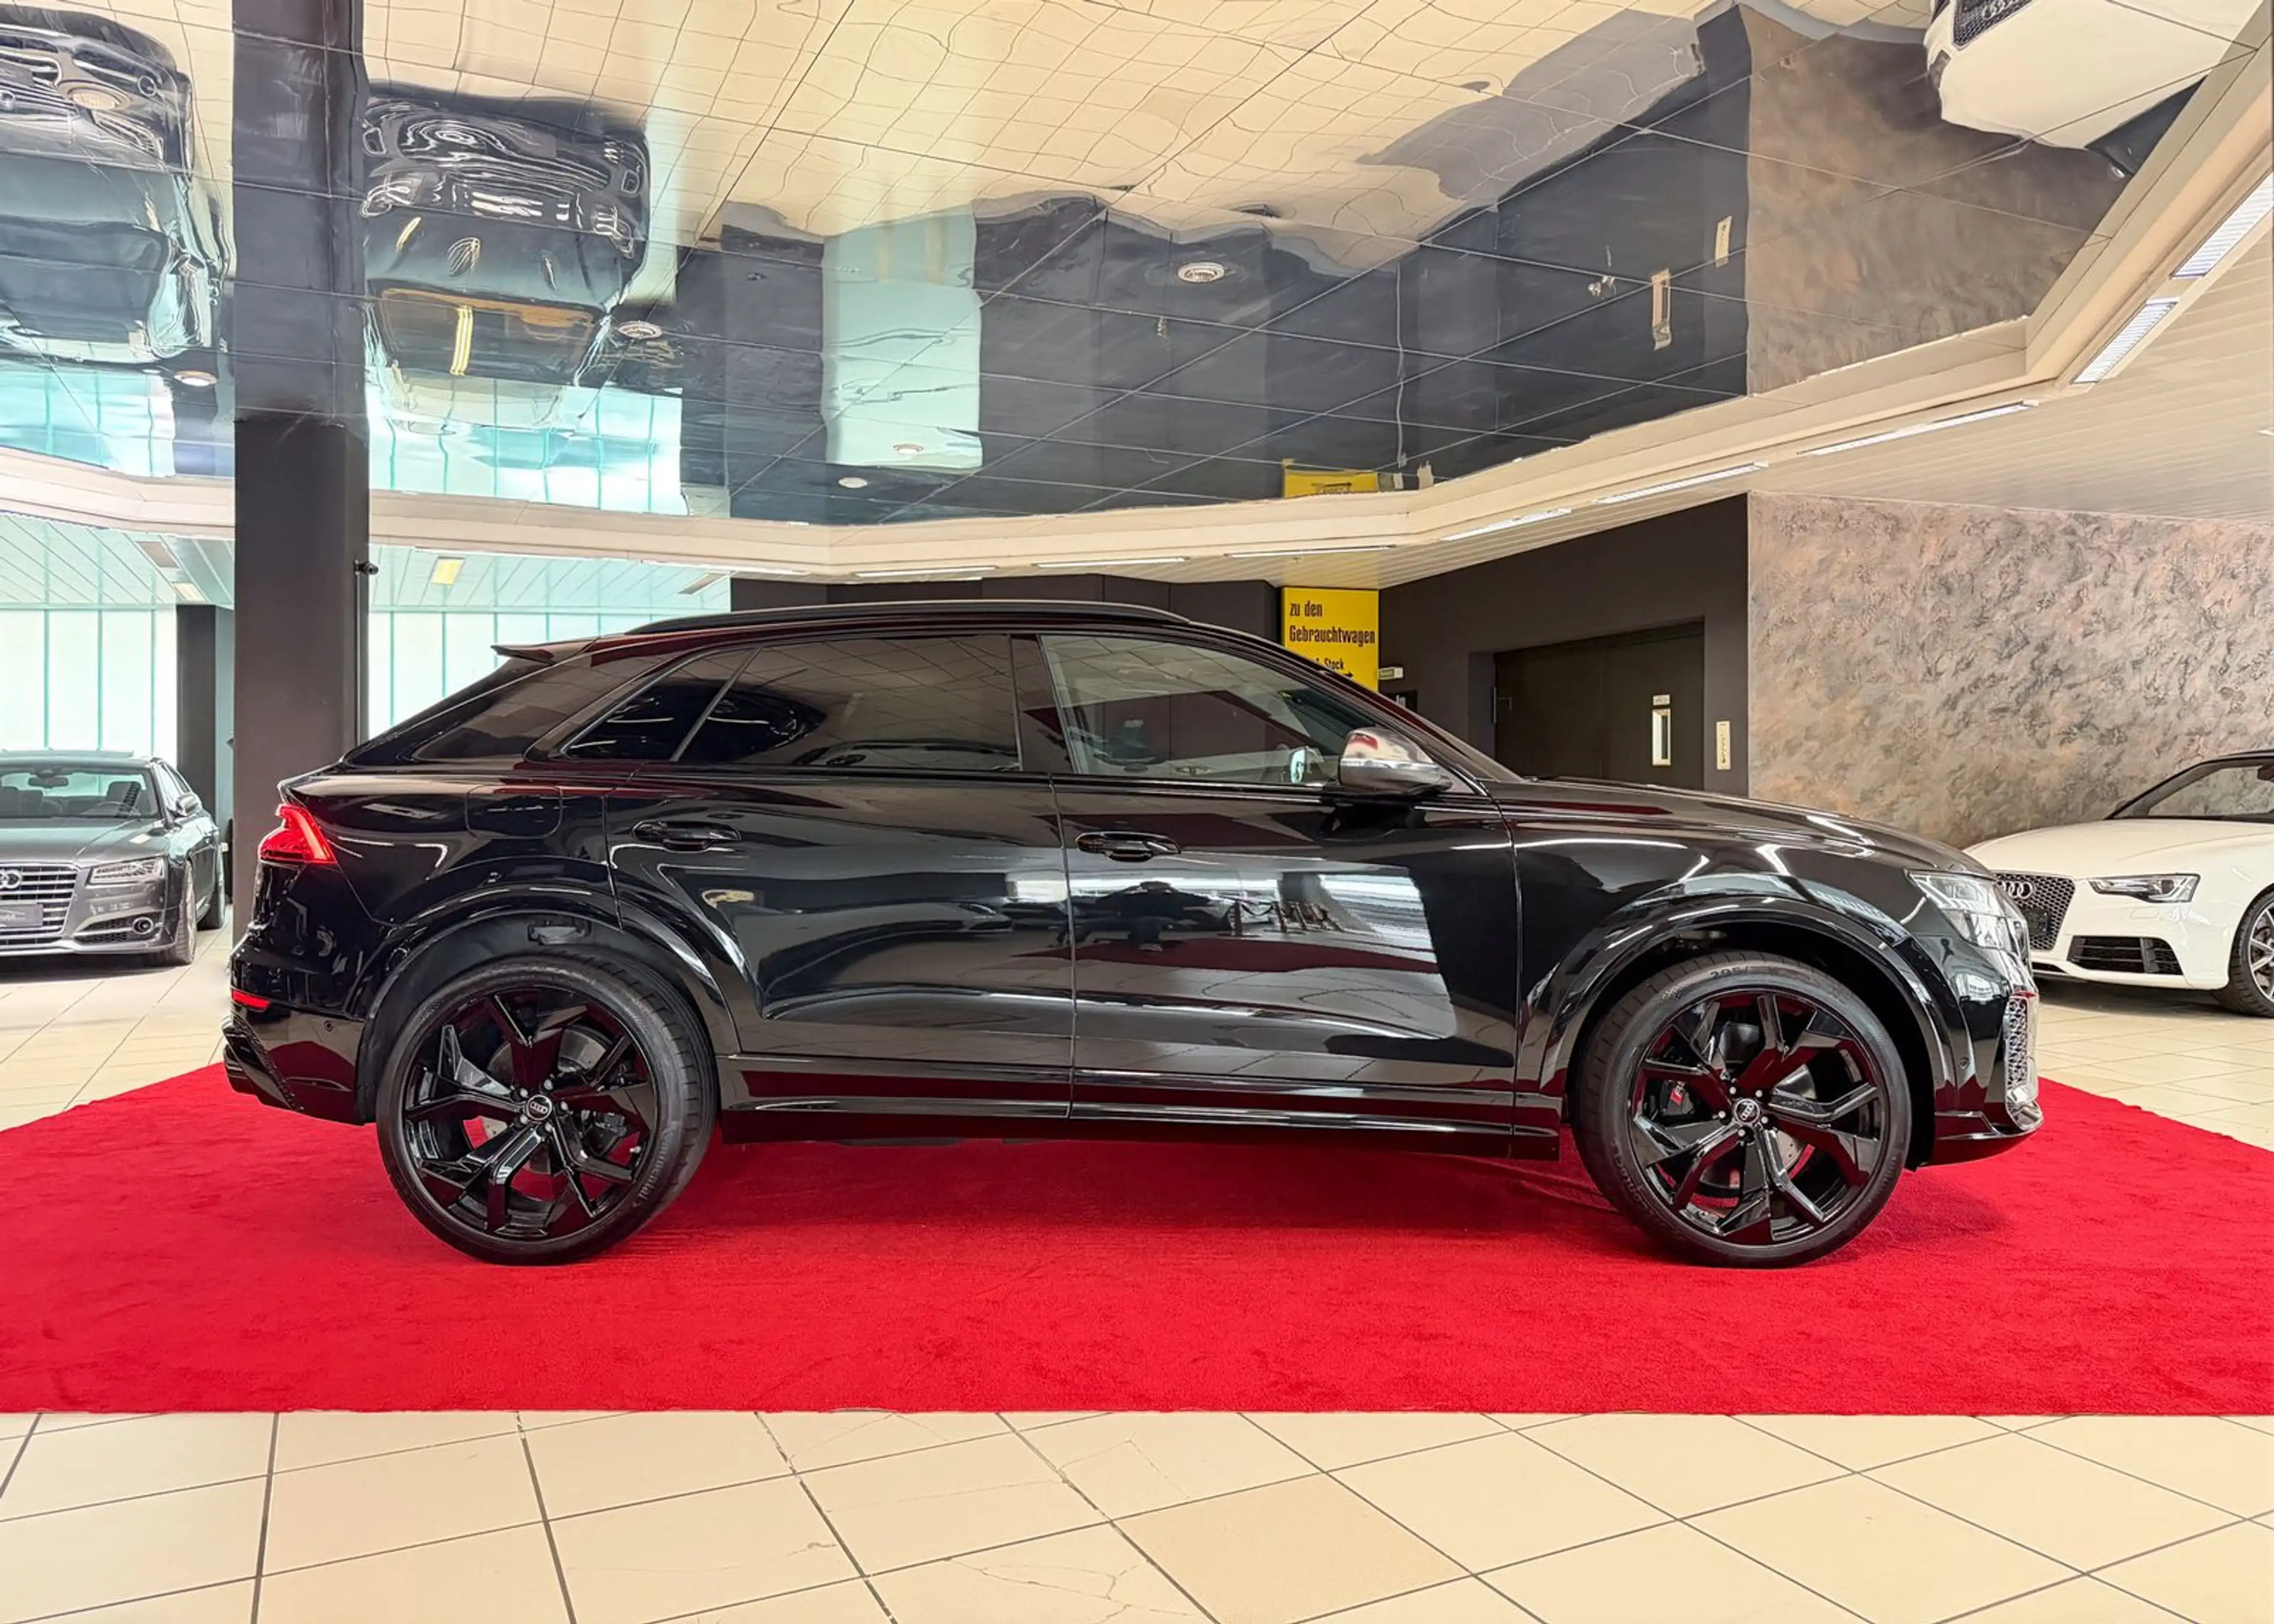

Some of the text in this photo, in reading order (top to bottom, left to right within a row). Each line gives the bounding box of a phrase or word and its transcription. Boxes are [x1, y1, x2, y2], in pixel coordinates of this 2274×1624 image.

[1290, 600, 1323, 617] zu den
[1289, 625, 1376, 647] Gebrauchtwagen
[1324, 657, 1344, 670] Stock
